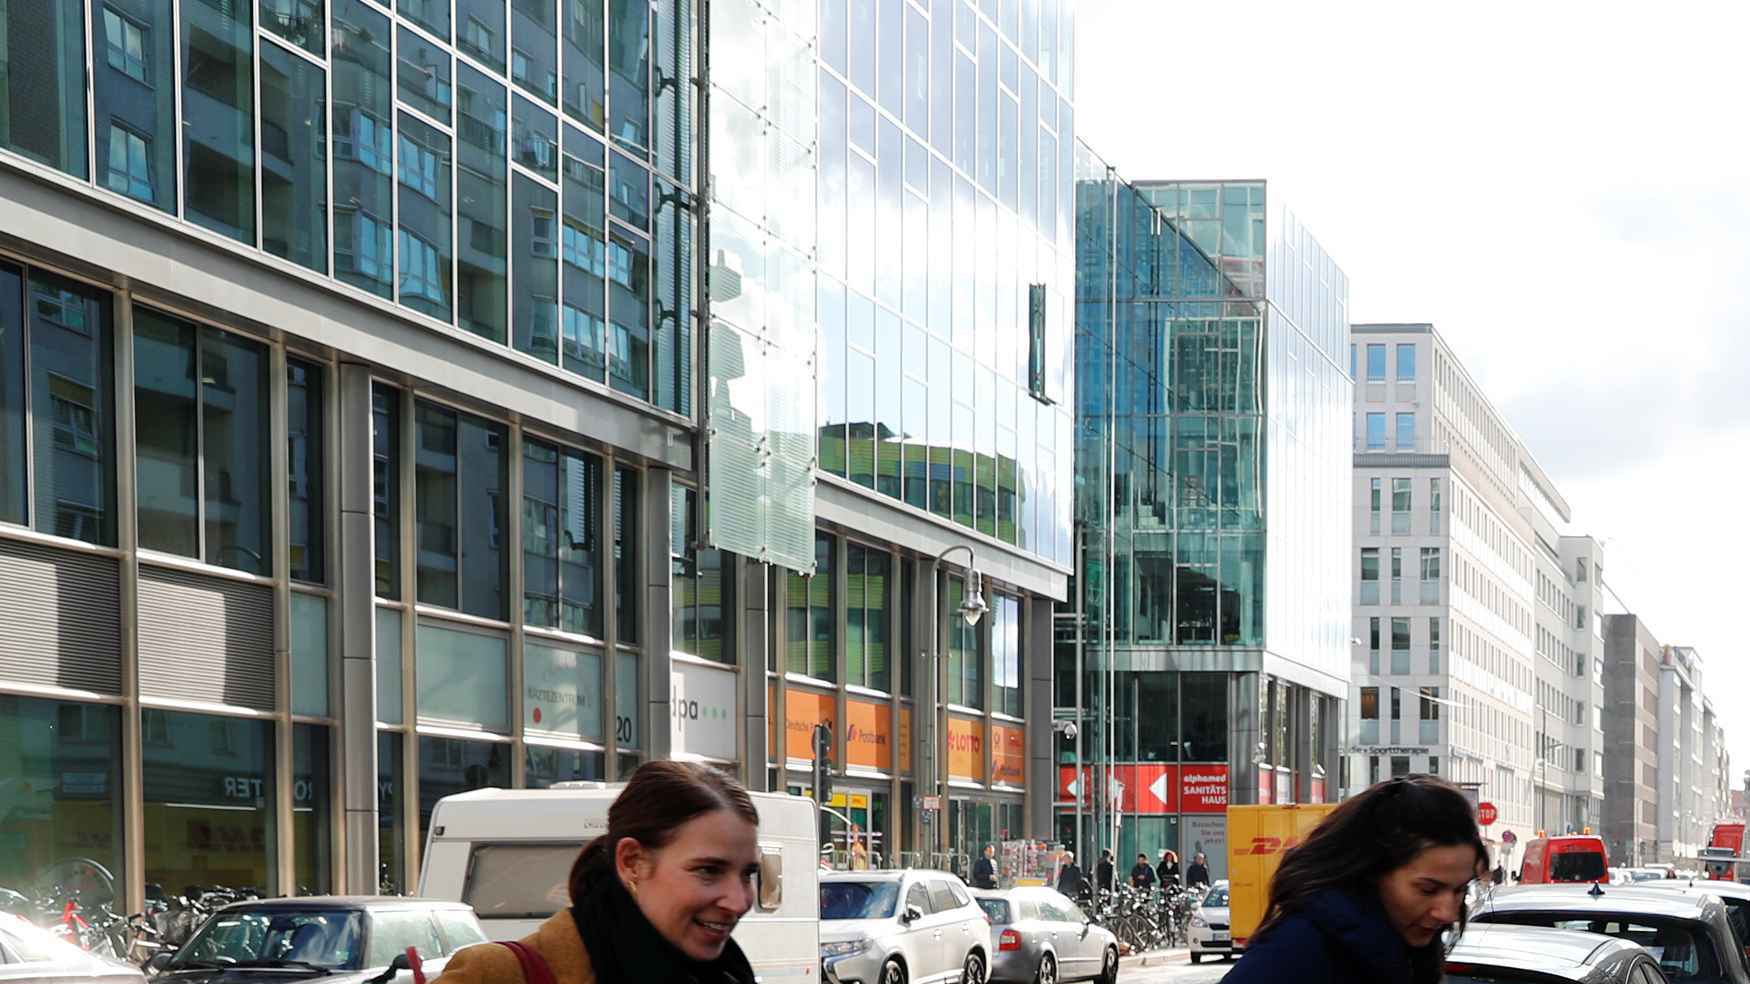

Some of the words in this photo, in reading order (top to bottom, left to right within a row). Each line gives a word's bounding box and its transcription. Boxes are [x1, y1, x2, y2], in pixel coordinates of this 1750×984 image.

[616, 715, 633, 743] 20
[955, 733, 981, 754] LOTTO
[1183, 774, 1227, 785] alphamed
[1183, 784, 1227, 795] SANITÄTS
[1201, 795, 1227, 805] HAUS
[1478, 808, 1496, 820] TOP
